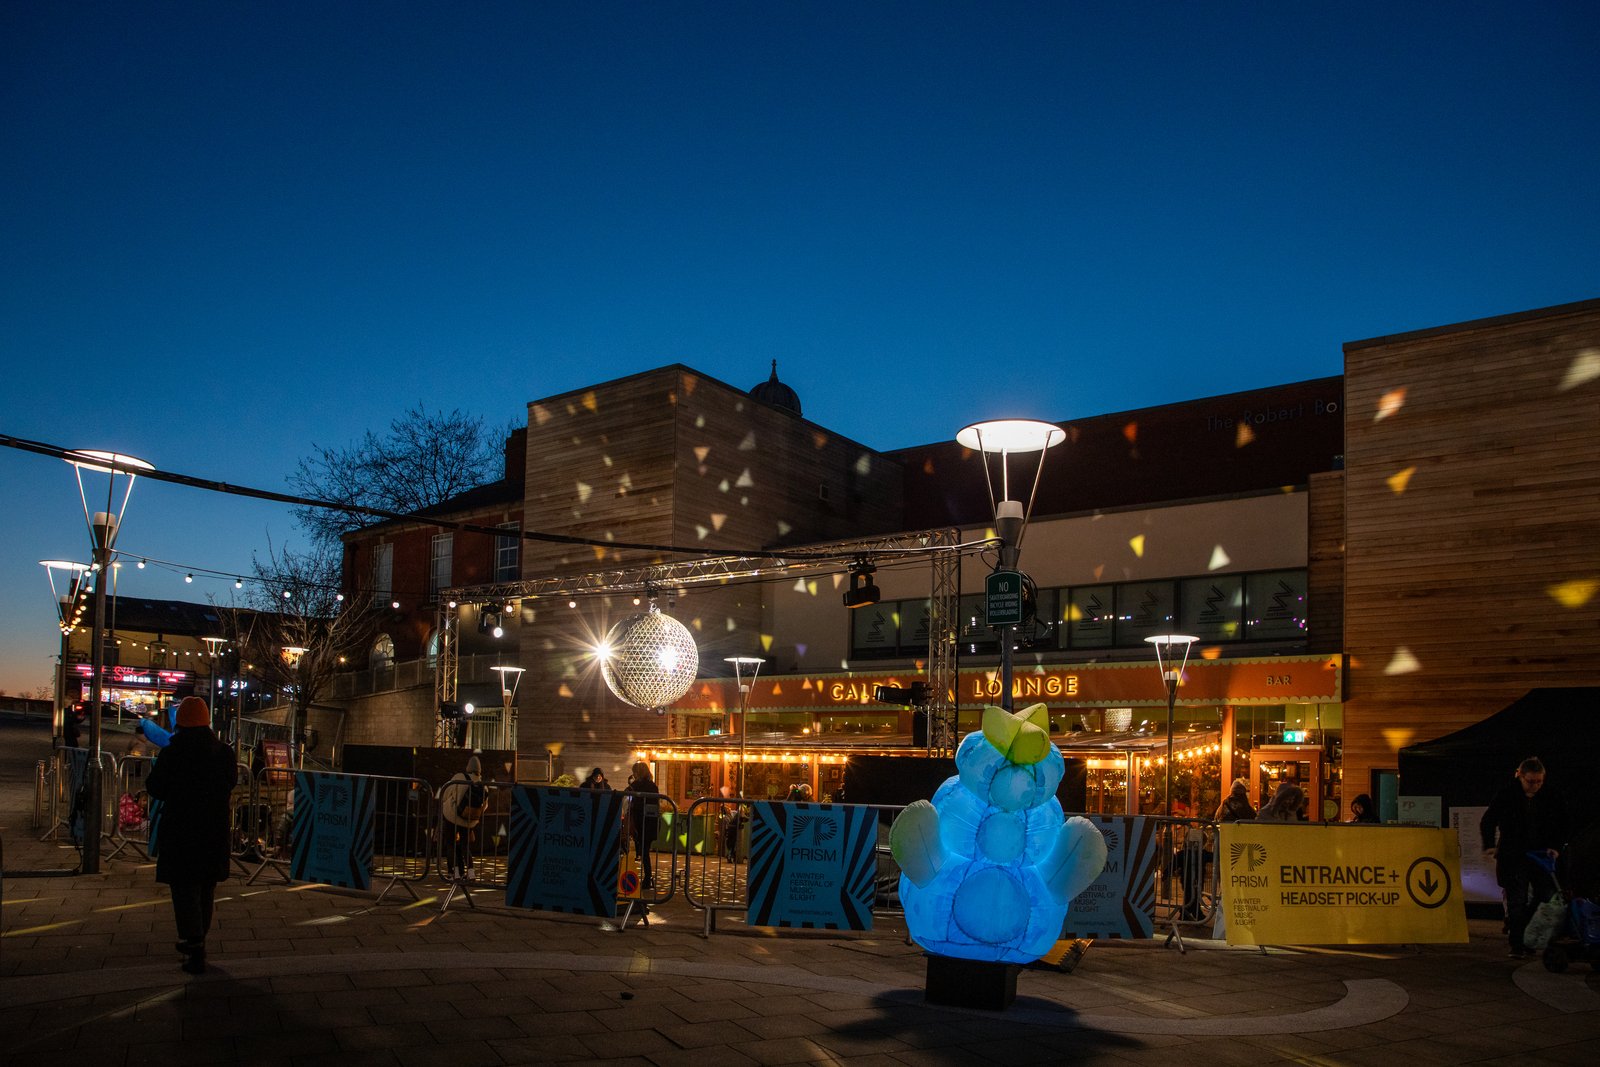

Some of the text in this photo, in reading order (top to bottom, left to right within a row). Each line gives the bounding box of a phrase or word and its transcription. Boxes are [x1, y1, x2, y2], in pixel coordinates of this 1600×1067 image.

[1243, 403, 1305, 426] Robert
[998, 581, 1009, 592] NO
[1266, 675, 1292, 686] BAR
[318, 812, 348, 827] PRISM
[544, 833, 585, 848] PRISM
[791, 847, 837, 862] PRISM
[1231, 875, 1268, 888] PRISM
[1279, 865, 1385, 884] ENTRANCE
[1280, 891, 1400, 905] HEADSET PICK-UP
